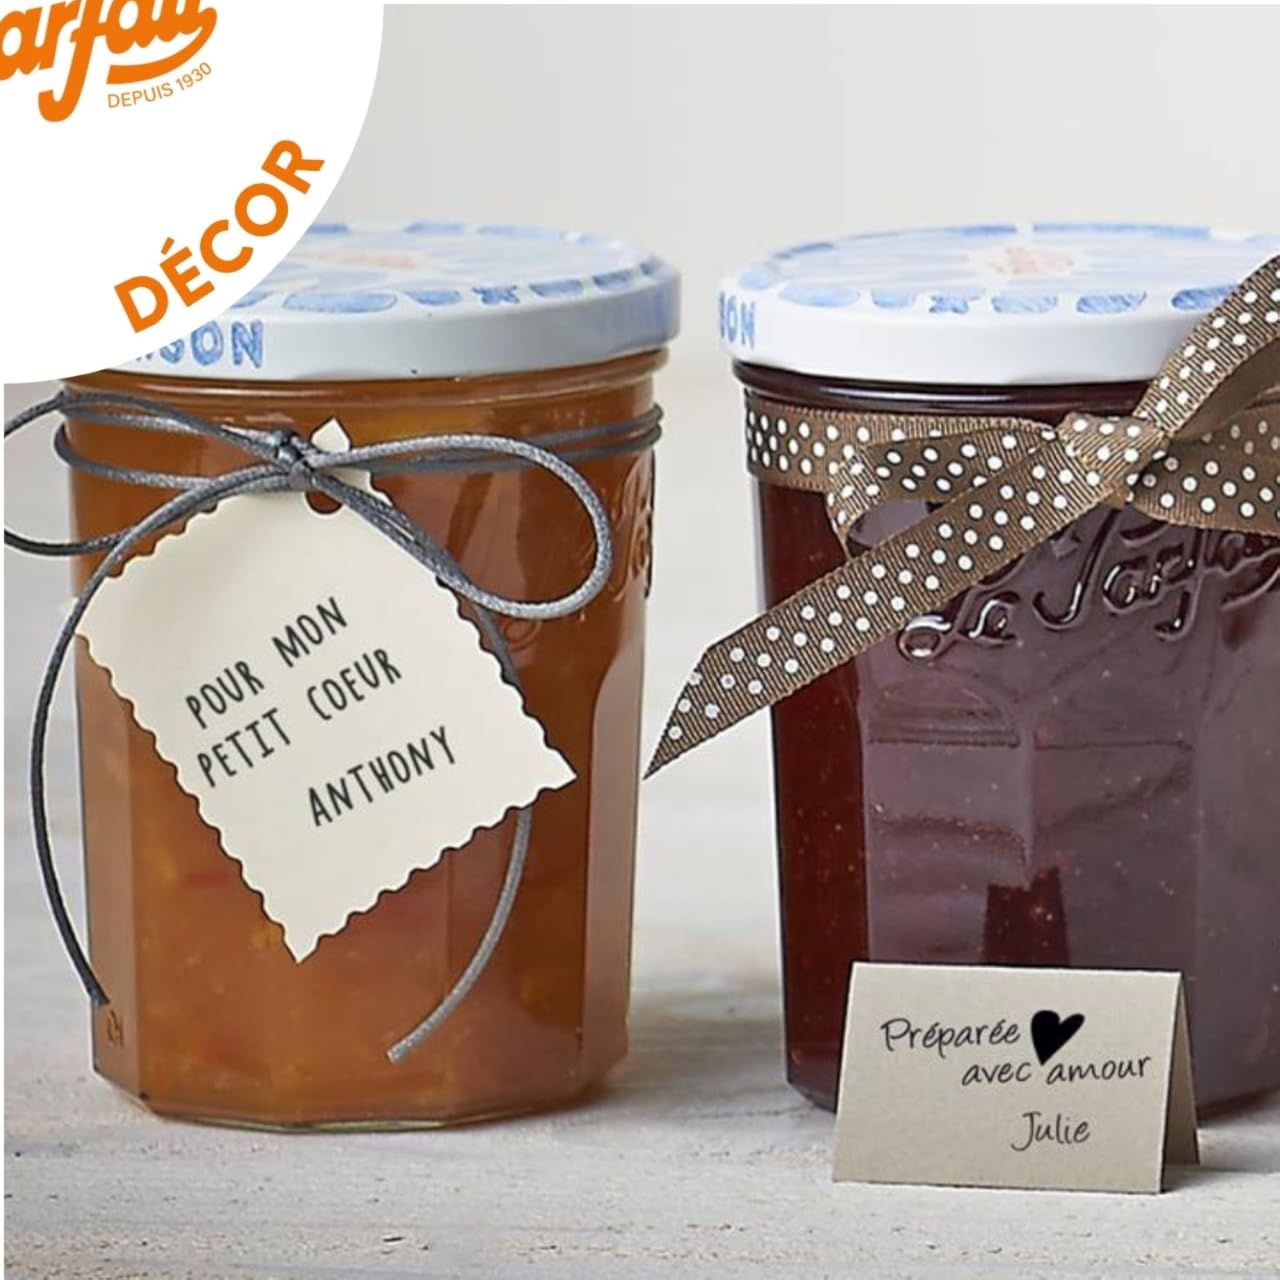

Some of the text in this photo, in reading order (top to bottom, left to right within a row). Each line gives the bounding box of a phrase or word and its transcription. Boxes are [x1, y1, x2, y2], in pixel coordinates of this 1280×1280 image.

[185, 596, 348, 730] POUR MON
[196, 648, 403, 788] PETIT COEUR
[307, 725, 456, 827] ANTHONY
[880, 1018, 1021, 1059] Préparée
[961, 1054, 1152, 1086] avec amour
[1011, 1110, 1091, 1152] Julie
